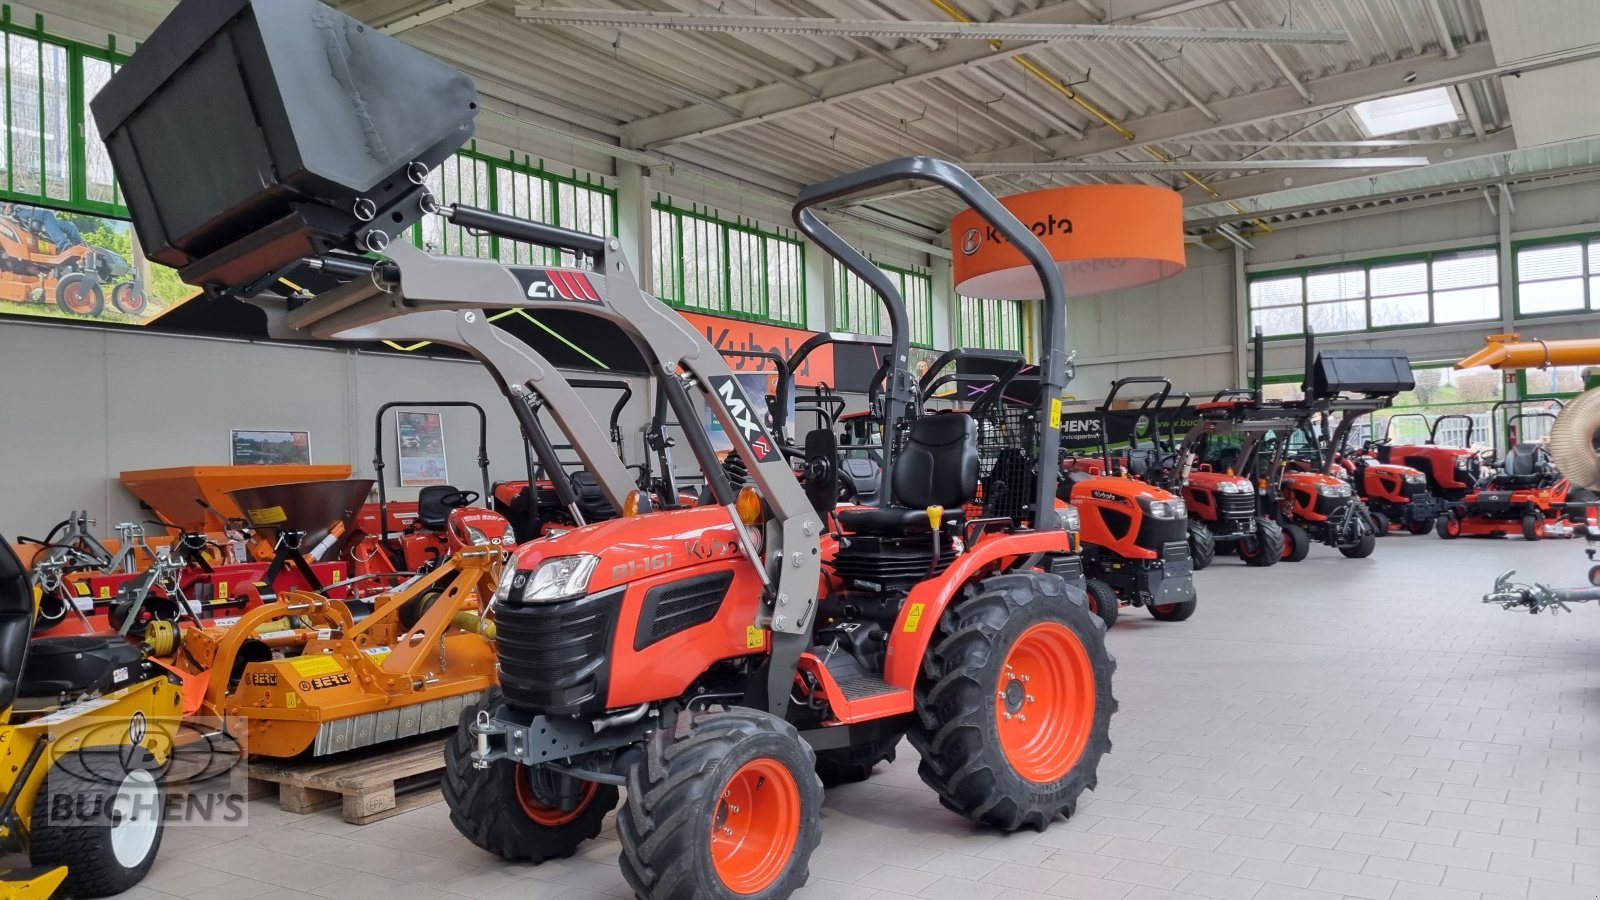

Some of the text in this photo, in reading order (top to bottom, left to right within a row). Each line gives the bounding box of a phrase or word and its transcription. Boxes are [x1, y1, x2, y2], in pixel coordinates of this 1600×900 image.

[986, 214, 1073, 243] Kota
[528, 281, 555, 298] C1
[719, 380, 760, 441] MX
[1060, 419, 1100, 432] HEN'S
[1094, 490, 1116, 501] Kubota
[685, 538, 738, 559] Kubo
[612, 551, 673, 580] B1-161
